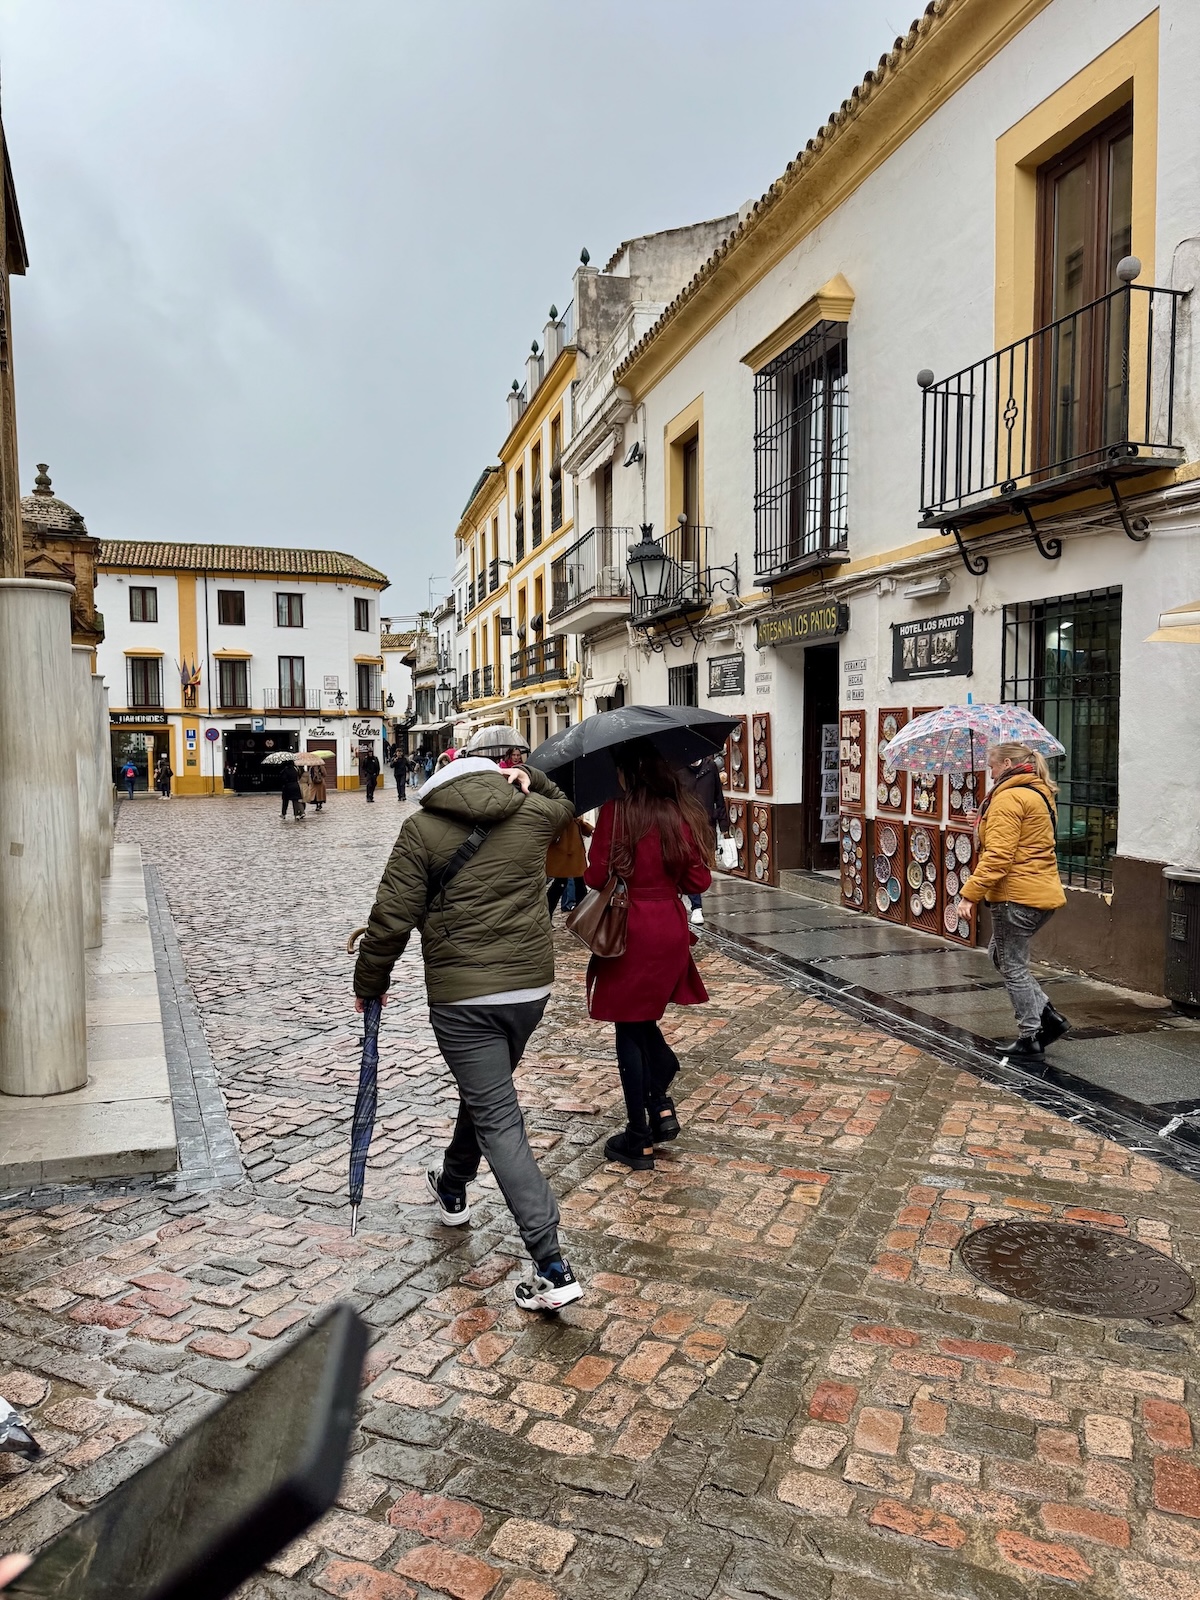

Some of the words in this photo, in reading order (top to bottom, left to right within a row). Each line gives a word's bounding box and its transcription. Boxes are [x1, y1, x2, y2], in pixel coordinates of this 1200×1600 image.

[758, 618, 792, 643] ARTESANIA
[794, 613, 808, 636] LOS
[810, 607, 837, 632] PATIOS
[900, 624, 922, 636] HOTEL
[923, 620, 937, 631] LOS
[938, 615, 965, 629] PATIOS
[252, 718, 264, 731] P
